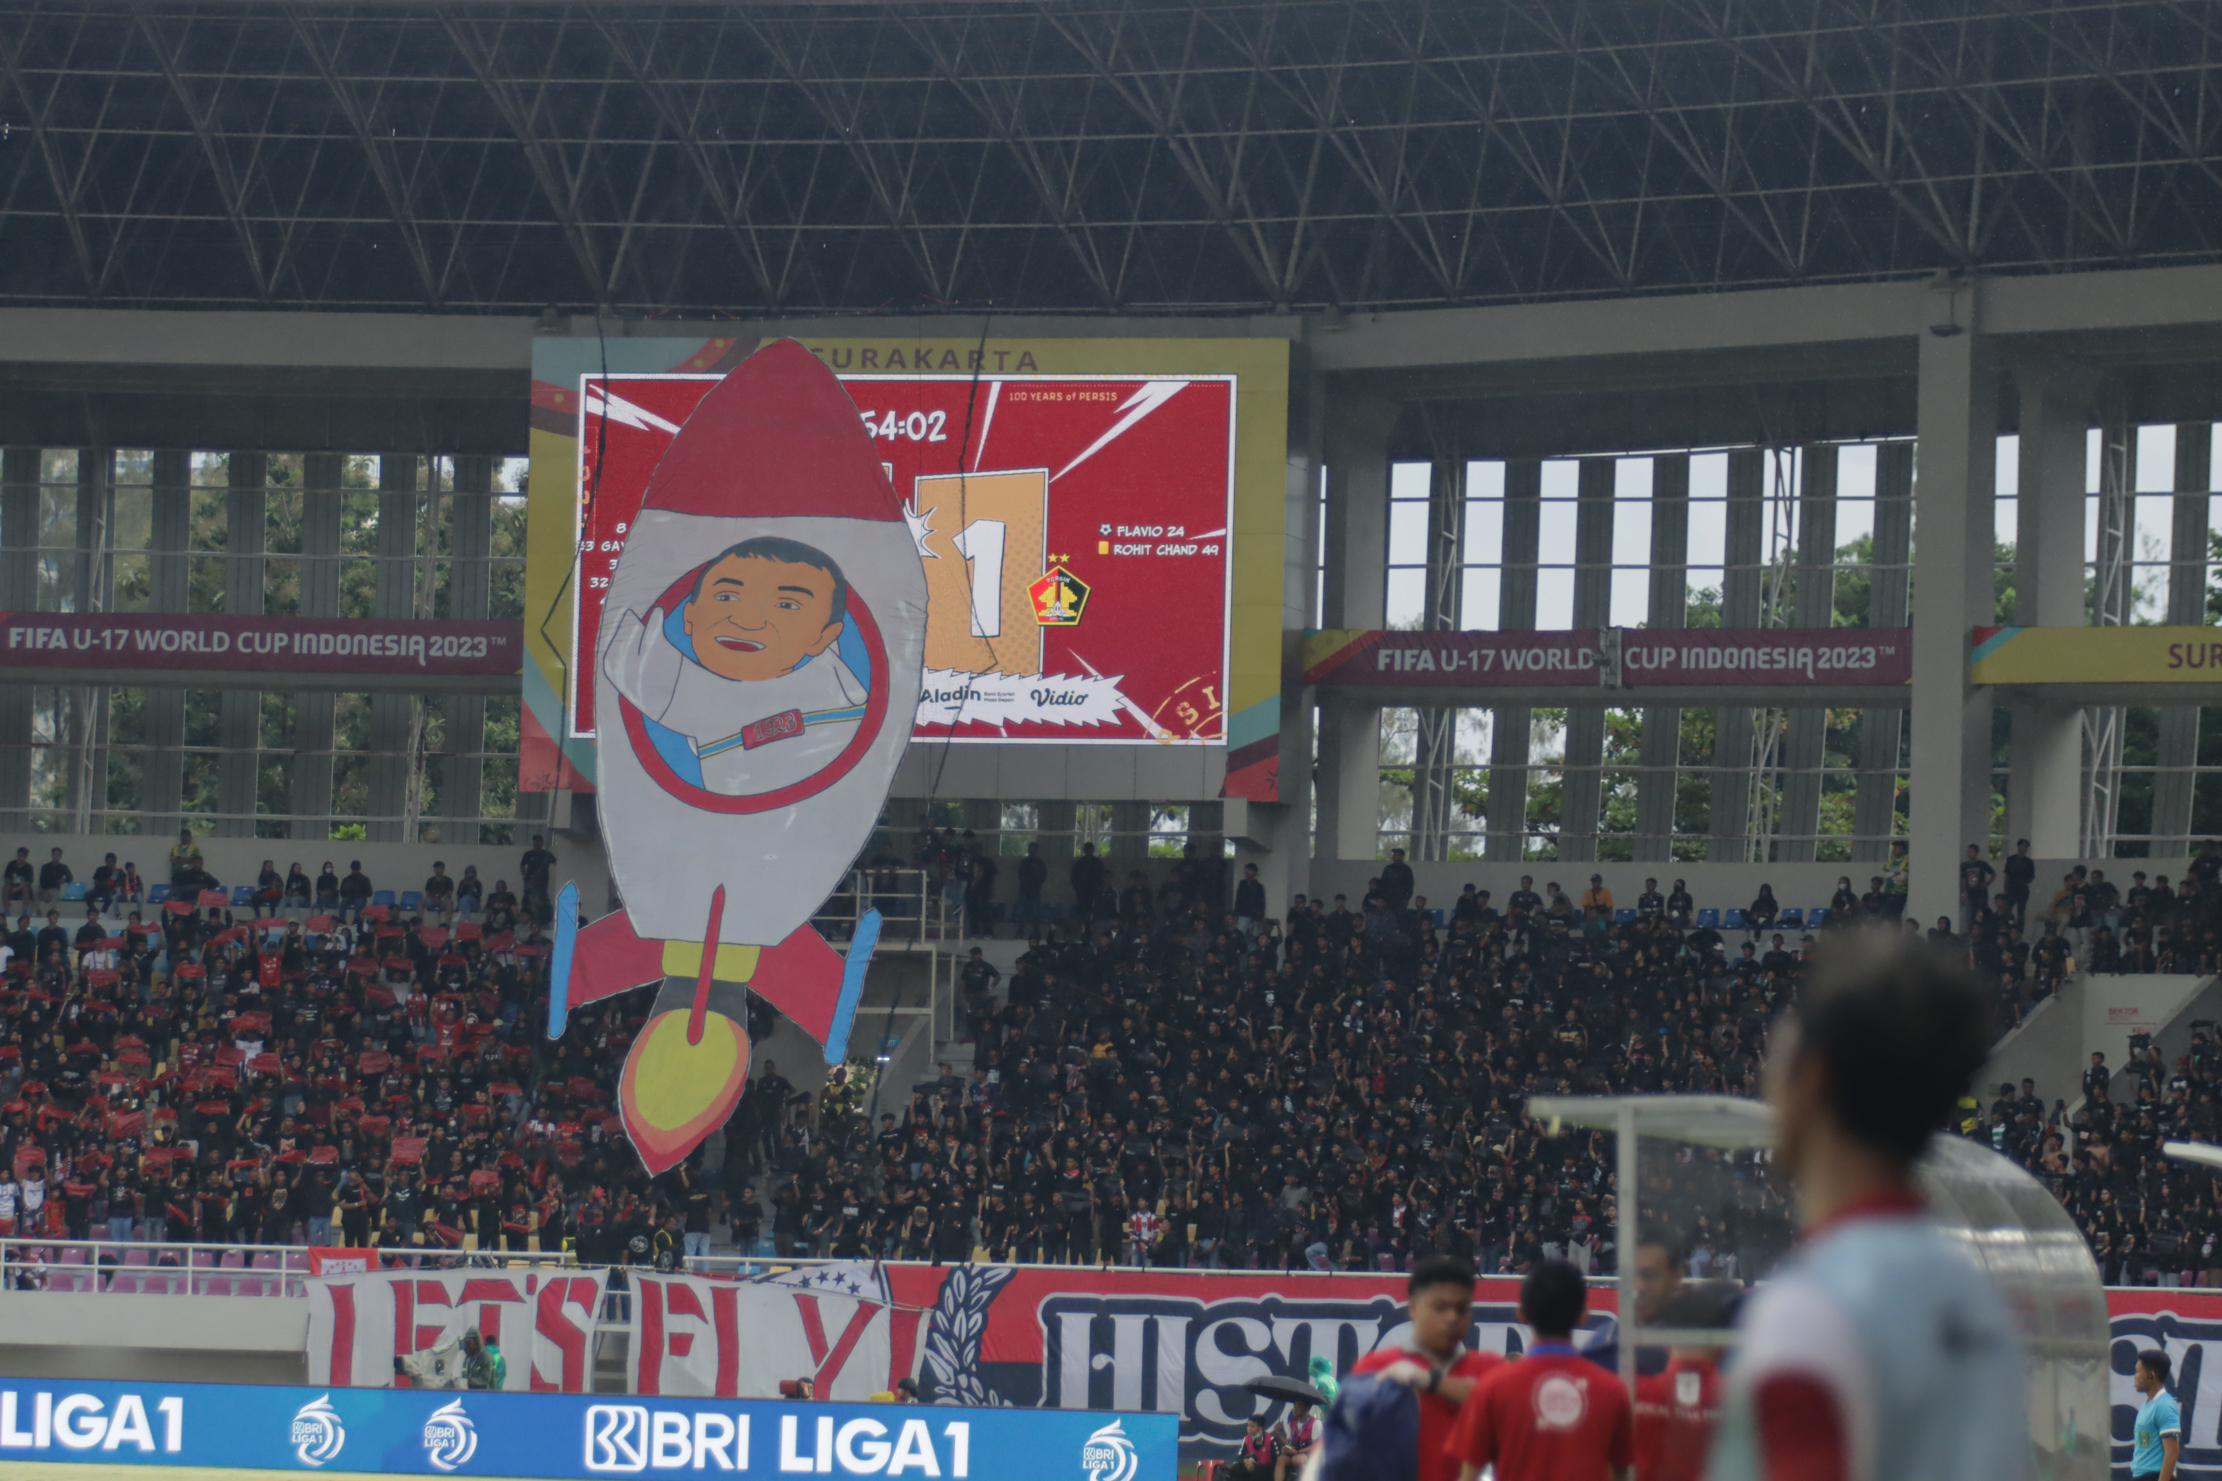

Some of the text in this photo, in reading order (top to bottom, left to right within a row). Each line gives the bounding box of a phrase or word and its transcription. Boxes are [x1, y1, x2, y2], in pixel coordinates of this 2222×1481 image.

[1009, 391, 1118, 402] 100 YEARS of PERSIS
[859, 410, 947, 442] 54:02
[1117, 525, 1185, 537] FLAVIO 24
[1113, 544, 1219, 556] ROHIT CHAND 49
[951, 519, 1006, 638] 1
[10, 627, 68, 649] FIFA
[74, 628, 129, 650] U-17
[135, 629, 230, 652] WORLD
[238, 632, 289, 653] CUP
[294, 633, 426, 666] INDONESIA
[429, 636, 488, 657] 2023
[1378, 649, 1436, 671] FIFA
[1441, 649, 1496, 671] U-17
[1501, 648, 1595, 671] WORLD
[1625, 647, 1676, 669] CUP
[1681, 647, 1814, 679] INDONESIA
[1817, 646, 1876, 669] 2023
[920, 685, 981, 703] Aladin
[1030, 688, 1089, 707] Vidio
[754, 713, 797, 741] 1923
[304, 1423, 323, 1434] BRI
[436, 1427, 455, 1438] BRI
[652, 1411, 750, 1470] BRI
[1096, 1448, 1115, 1460] BRI
